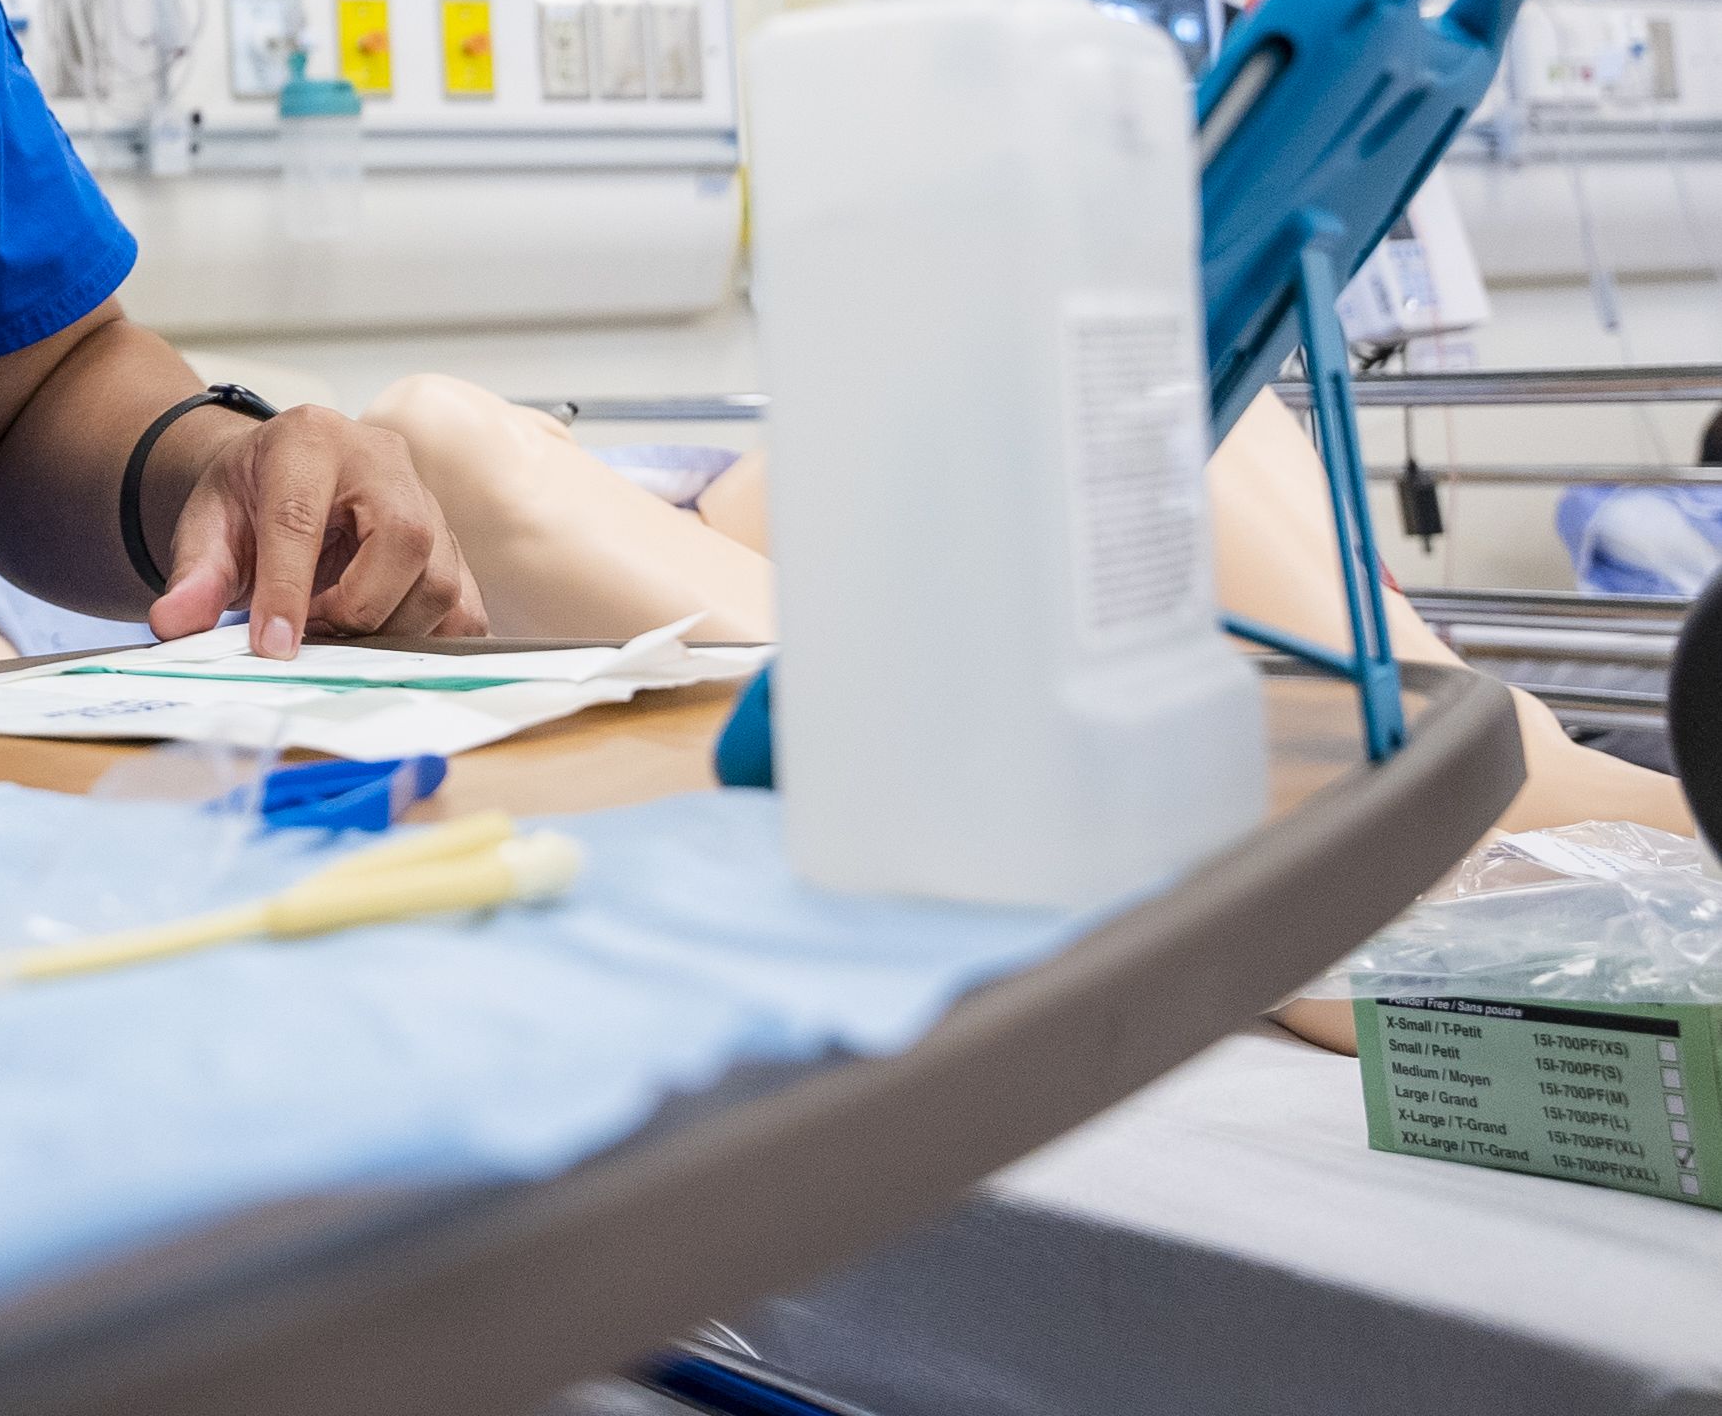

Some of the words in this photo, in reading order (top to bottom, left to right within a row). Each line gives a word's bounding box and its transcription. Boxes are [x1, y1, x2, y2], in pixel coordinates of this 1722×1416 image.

[1427, 998, 1449, 1010] Free
[1450, 1000, 1456, 1010] /
[1457, 1001, 1482, 1014] Sans
[1484, 1005, 1523, 1017] poudre
[1386, 1016, 1431, 1033] X-Small
[1434, 1022, 1440, 1034] /
[1441, 1022, 1482, 1039] T-Petit
[1389, 1039, 1422, 1055] Small
[1424, 1044, 1429, 1055] /
[1432, 1044, 1461, 1060] Petit
[1391, 1062, 1439, 1080] Medium
[1441, 1069, 1447, 1081] /
[1448, 1070, 1491, 1087] Moyen
[1395, 1085, 1429, 1103] Large
[1432, 1090, 1437, 1102] /
[1439, 1092, 1478, 1108] Grand
[1398, 1108, 1445, 1128] X-Large
[1448, 1114, 1453, 1125] /
[1454, 1116, 1507, 1135] T-Grand
[1401, 1131, 1458, 1153] XX-Large
[1461, 1141, 1466, 1152] /
[1467, 1141, 1530, 1162] TT-Grand
